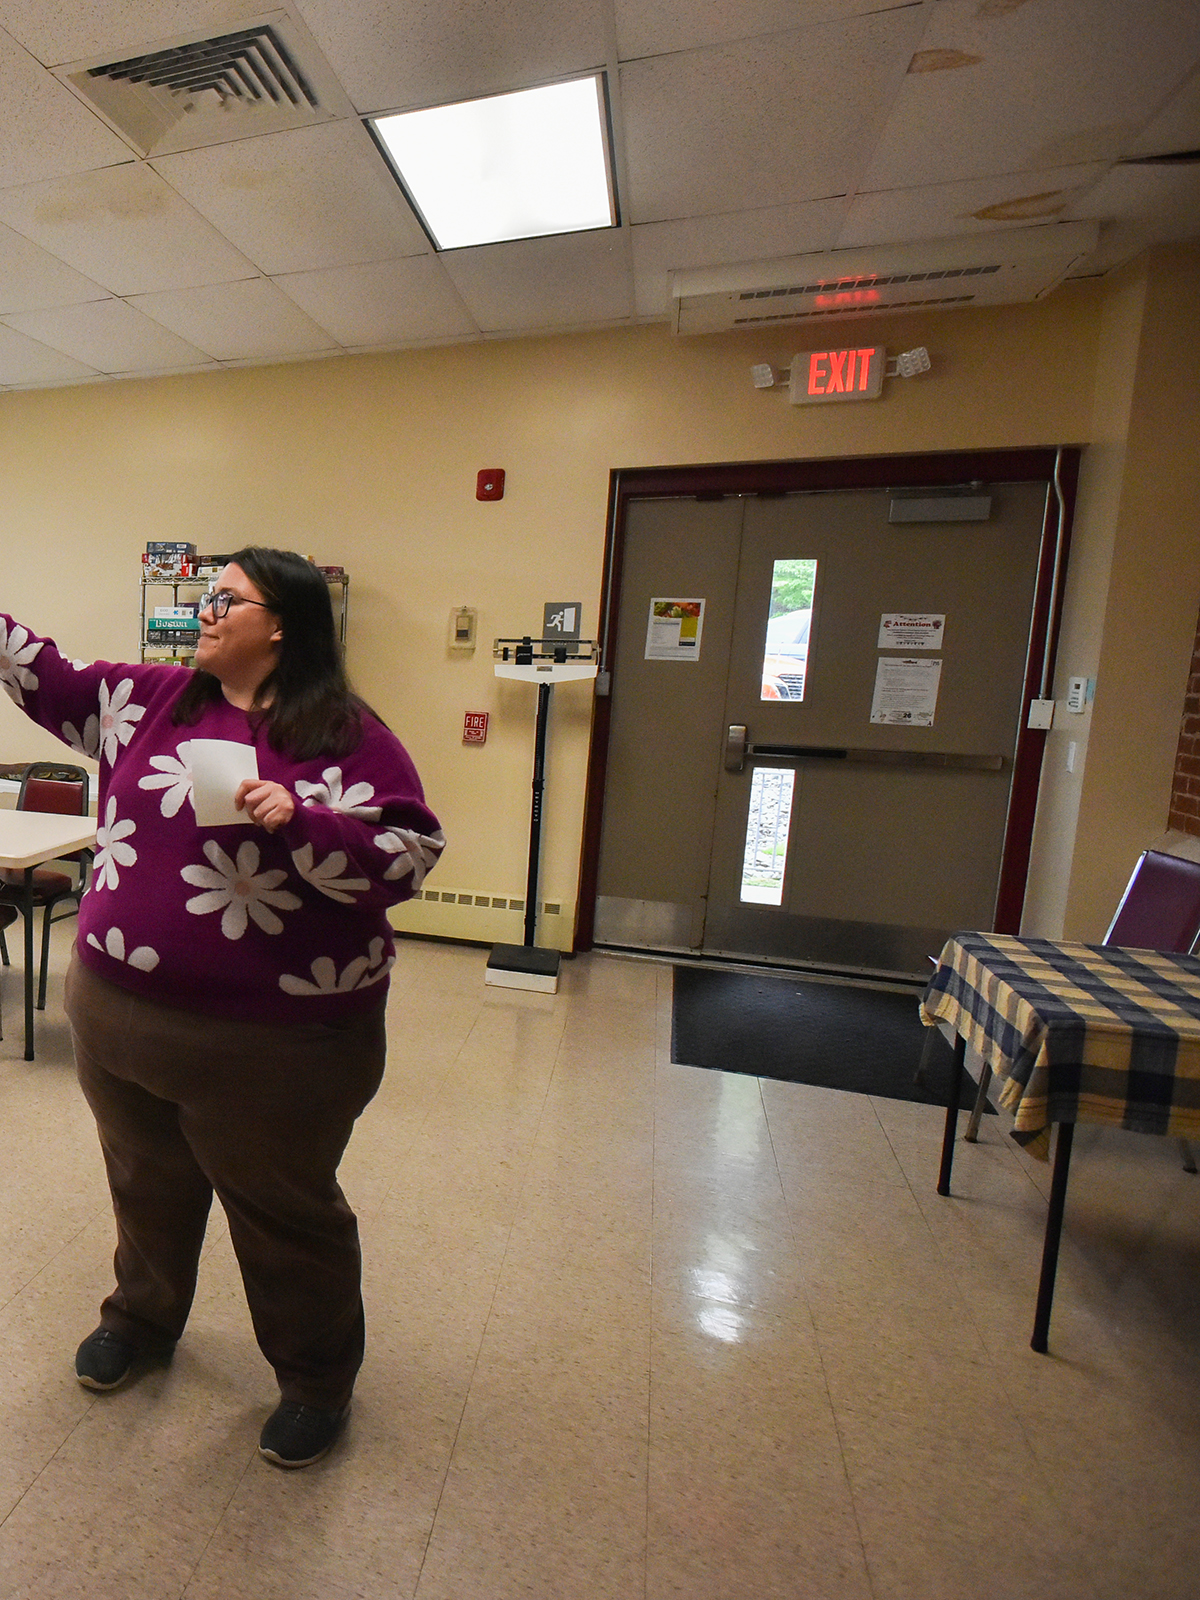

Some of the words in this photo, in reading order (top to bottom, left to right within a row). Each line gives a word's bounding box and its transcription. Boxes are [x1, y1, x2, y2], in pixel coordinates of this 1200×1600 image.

[807, 348, 875, 395] EXIT
[155, 619, 188, 628] Boston
[465, 715, 484, 728] FIRE
